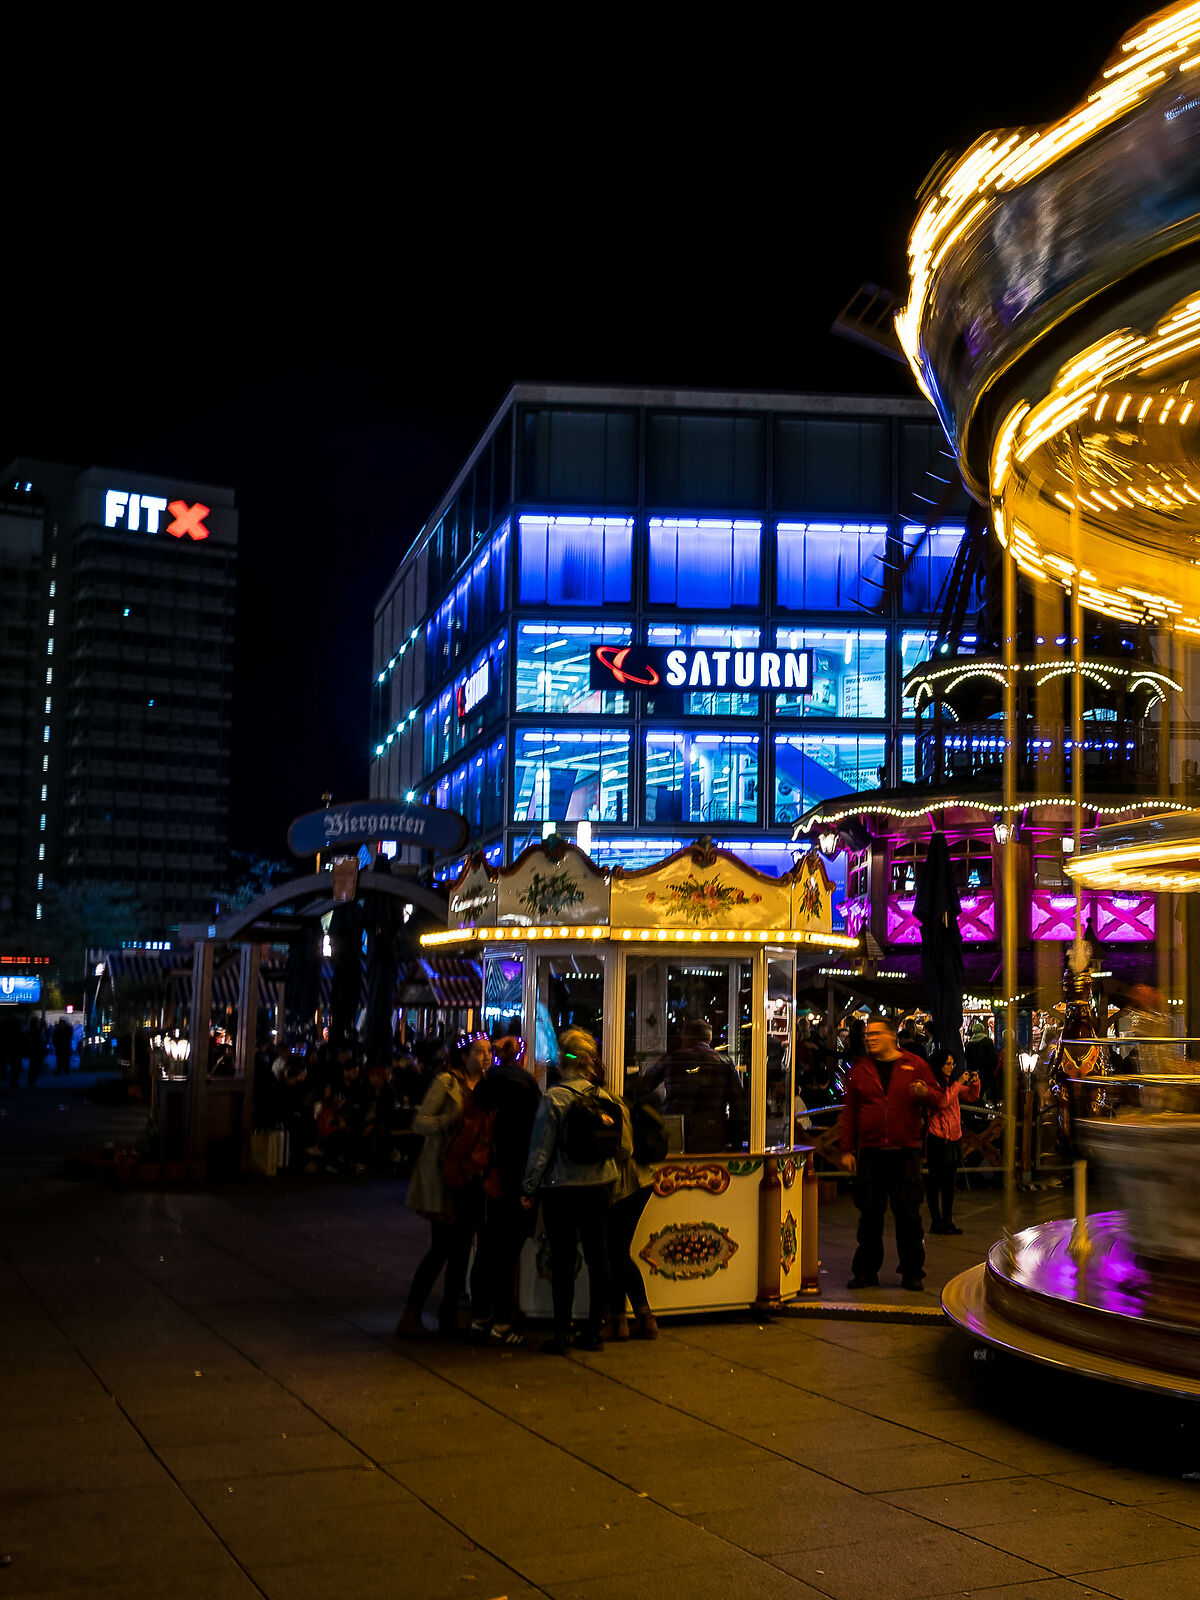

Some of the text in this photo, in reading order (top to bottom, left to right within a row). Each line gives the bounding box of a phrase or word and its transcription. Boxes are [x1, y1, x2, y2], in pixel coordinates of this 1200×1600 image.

[105, 490, 210, 541] FITX
[666, 650, 808, 688] SATURN
[324, 811, 426, 836] Biergarten
